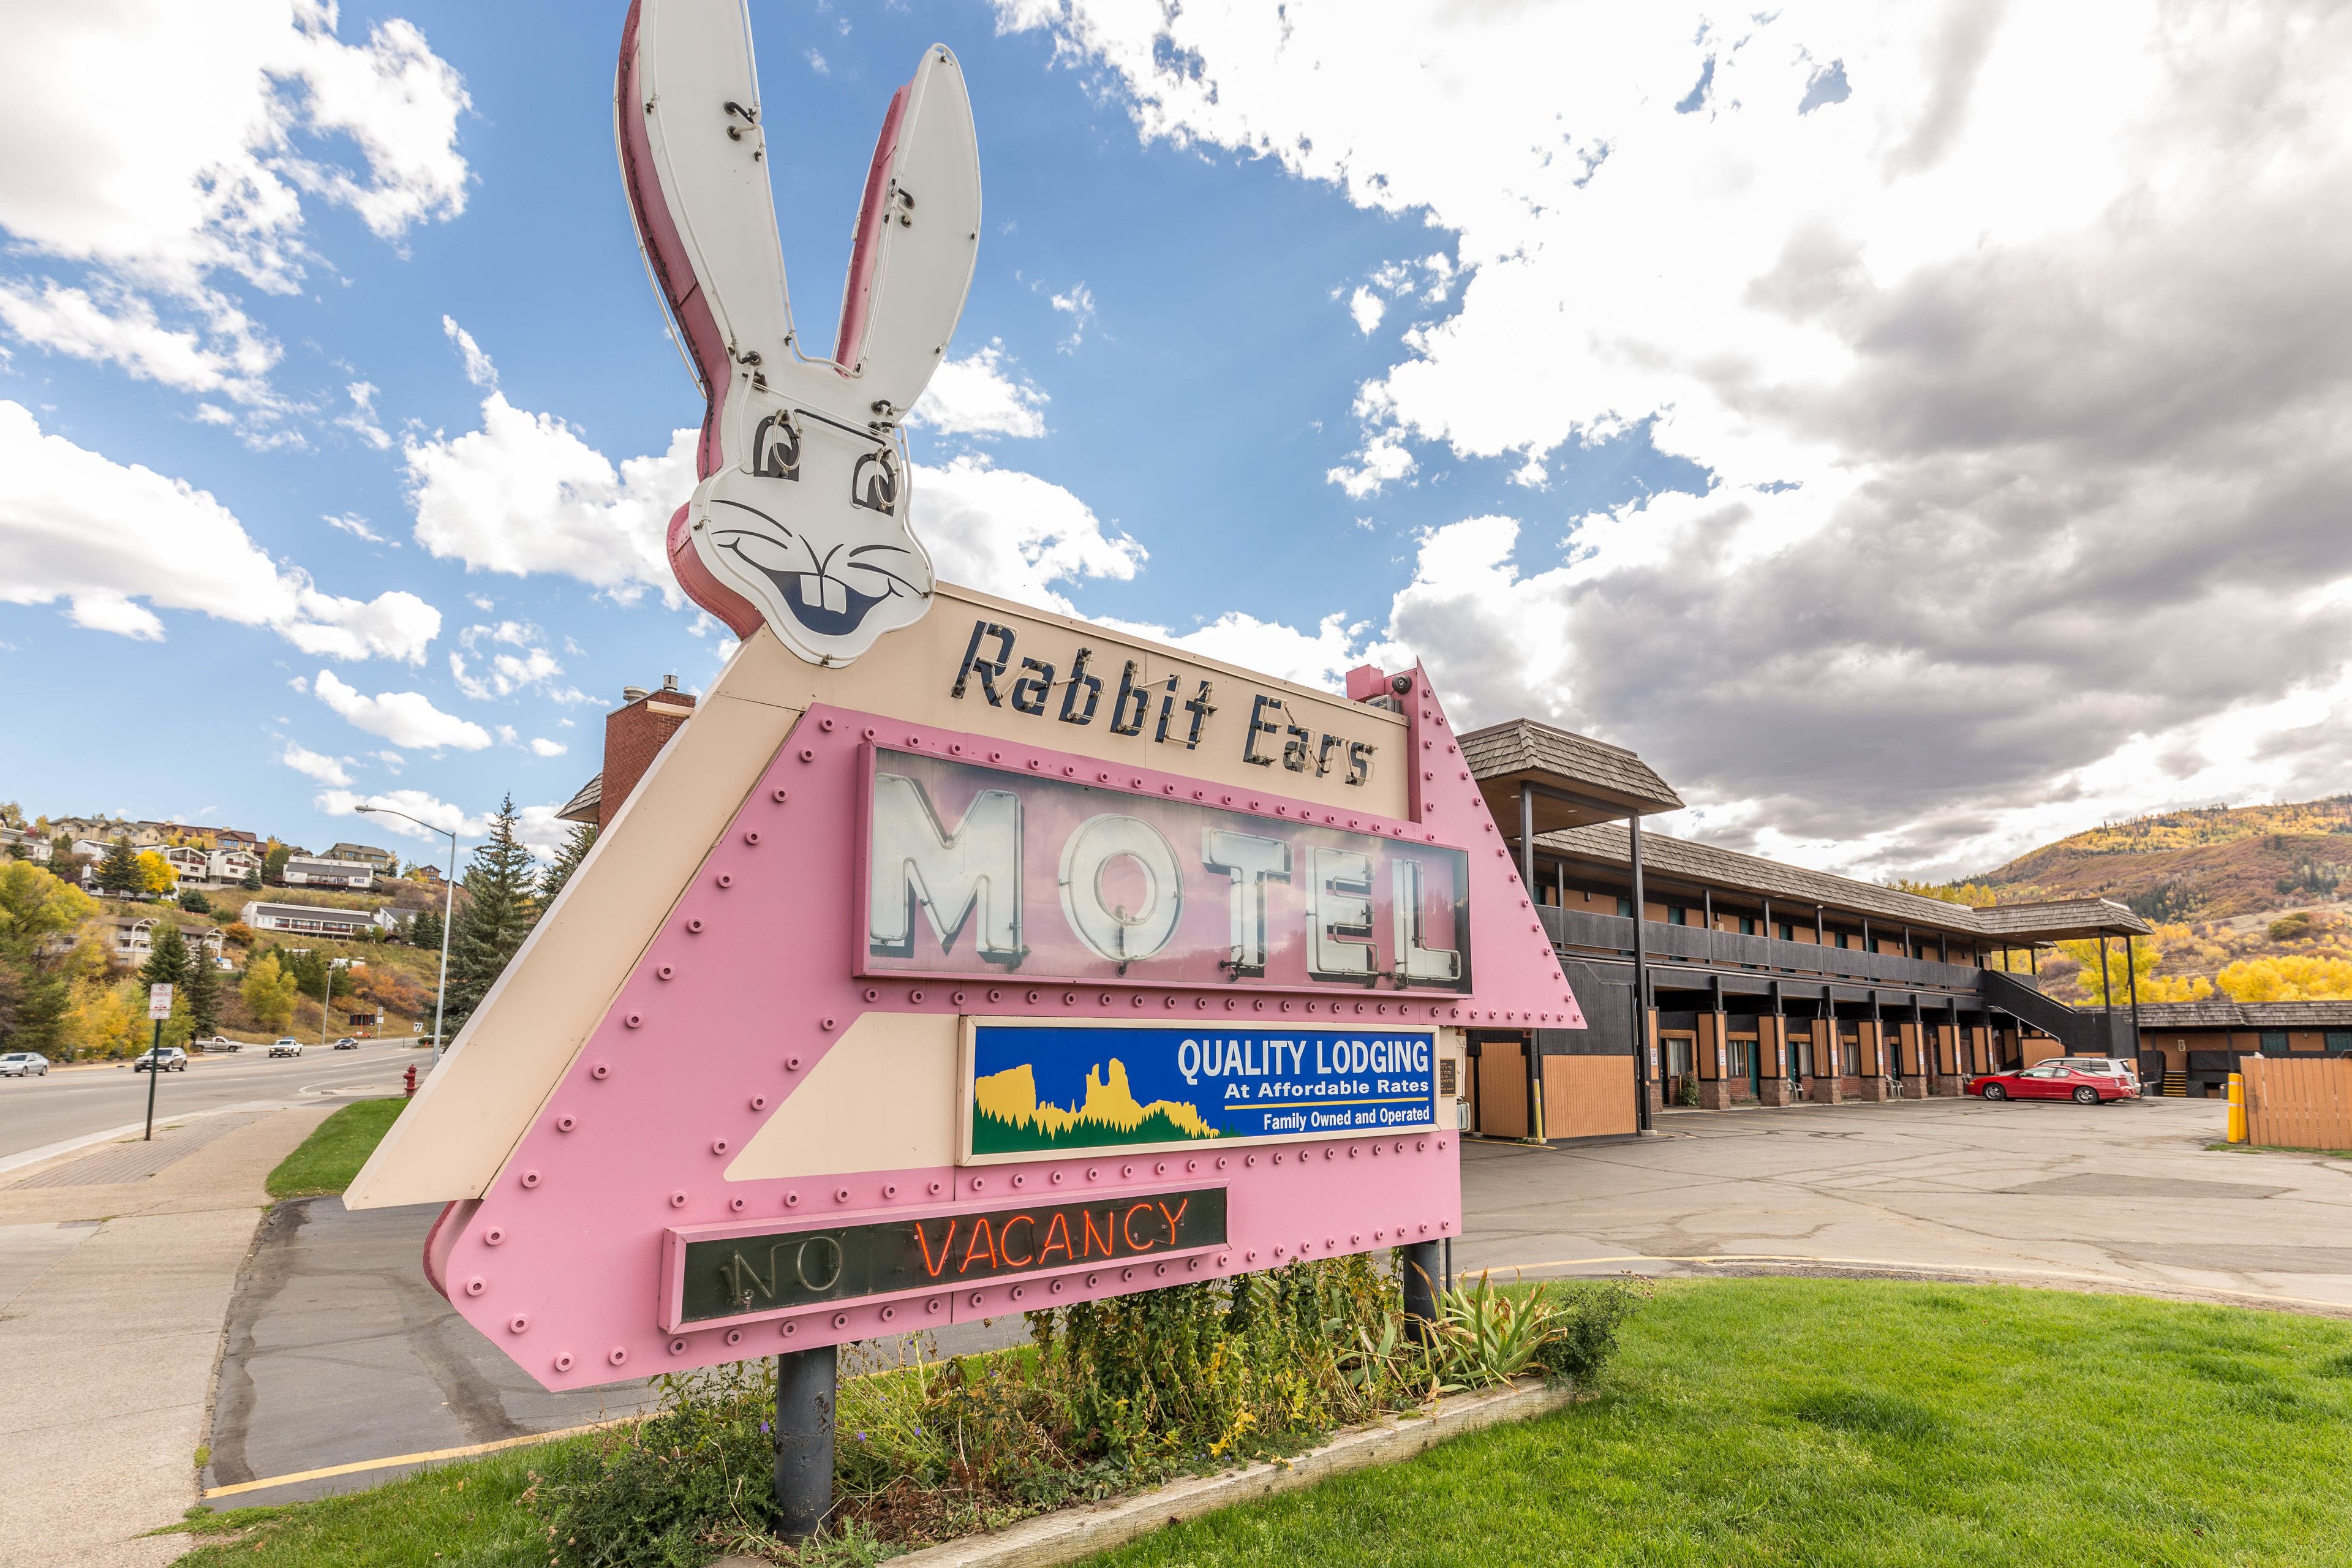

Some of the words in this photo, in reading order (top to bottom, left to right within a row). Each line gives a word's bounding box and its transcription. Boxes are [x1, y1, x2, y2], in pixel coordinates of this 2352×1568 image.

[951, 620, 1218, 750] Rabbit
[1243, 695, 1379, 786] Ears
[869, 772, 1461, 981] MOTEL
[1178, 1039, 1306, 1085] QUALITY
[1317, 1040, 1428, 1074] LODGING
[1224, 1084, 1250, 1098] At
[1258, 1080, 1369, 1097] Affordable
[1378, 1080, 1428, 1093] Rates
[1264, 1112, 1306, 1131] Family
[1311, 1110, 1351, 1127] Owned
[1355, 1109, 1376, 1125] and
[1380, 1106, 1430, 1125] Operated
[734, 1236, 843, 1305] NO
[915, 1198, 1188, 1277] VACANCY
